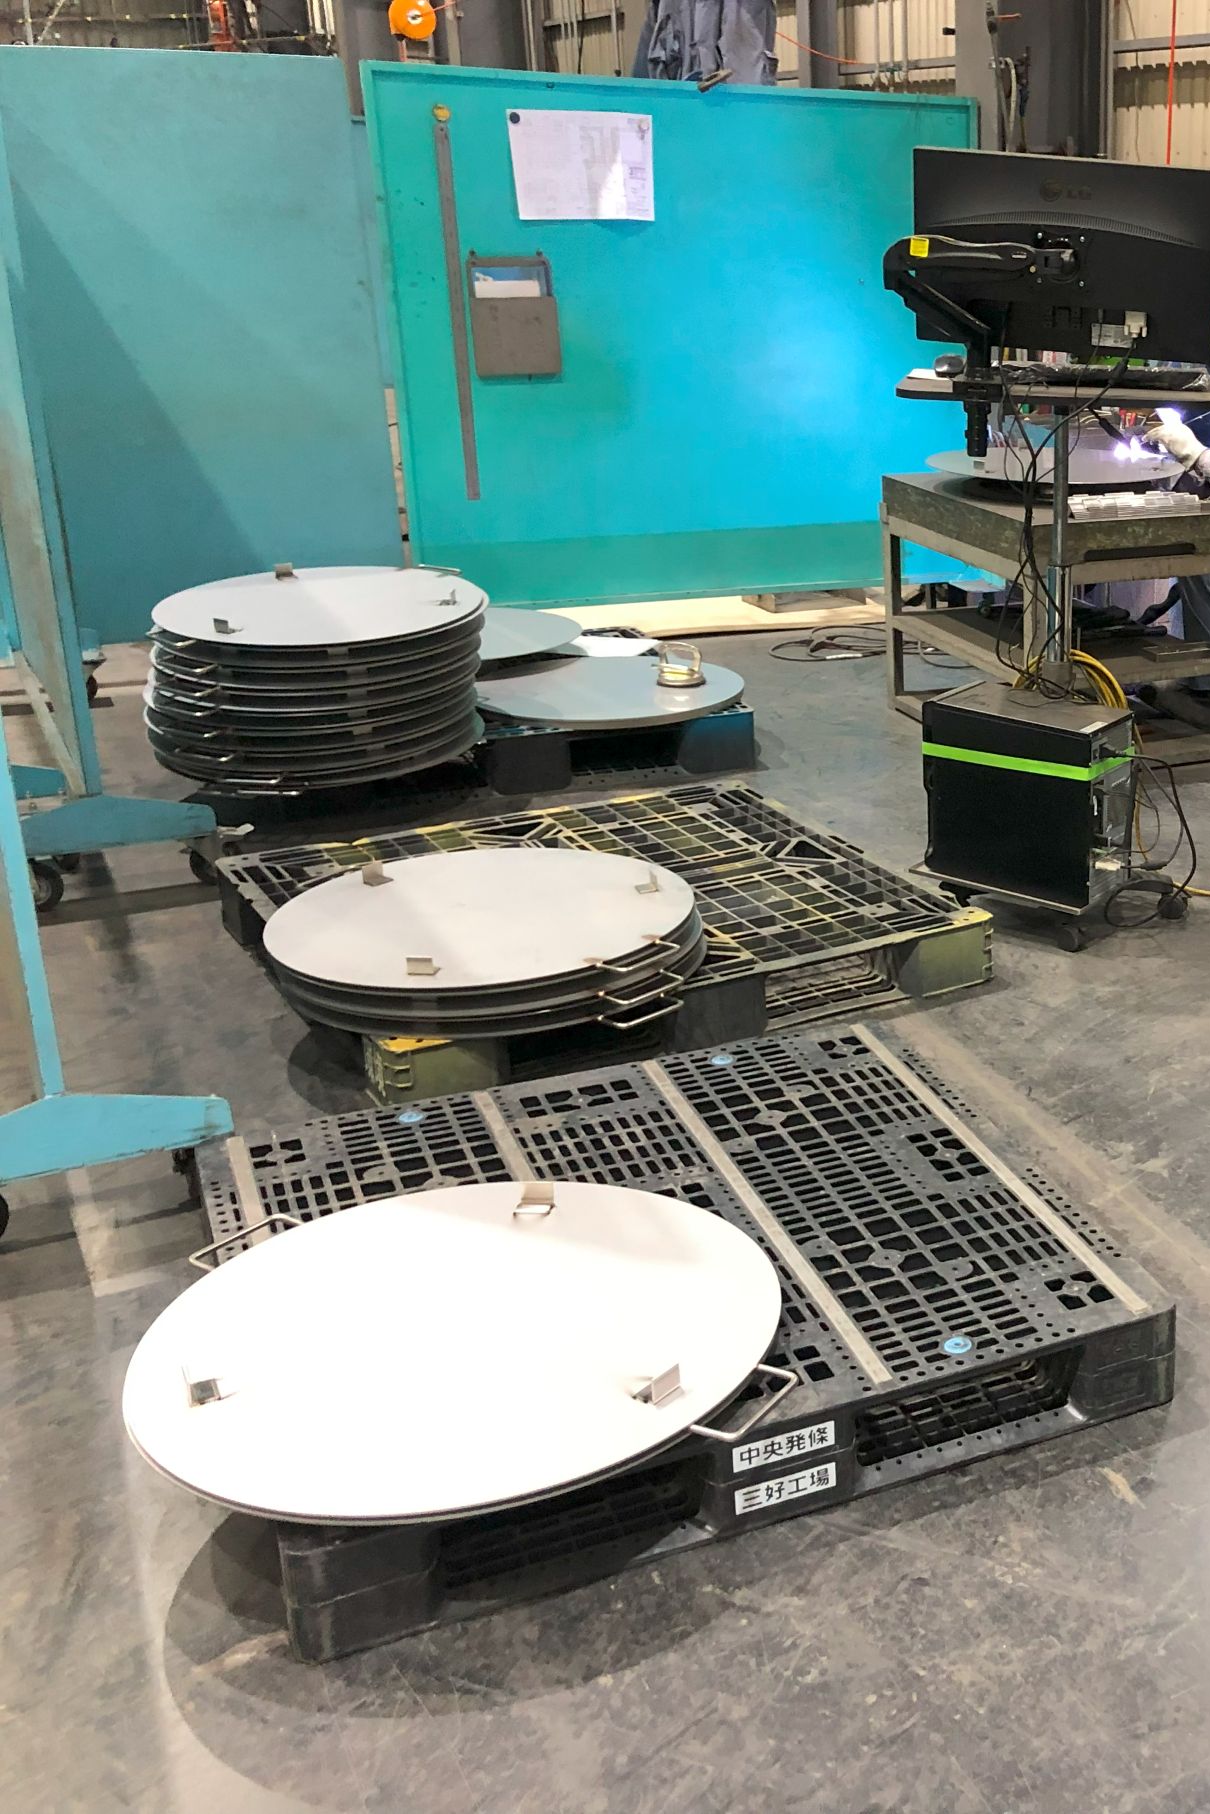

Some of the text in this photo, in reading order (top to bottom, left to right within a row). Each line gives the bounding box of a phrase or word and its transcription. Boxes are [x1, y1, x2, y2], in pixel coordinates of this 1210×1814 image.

[740, 1426, 829, 1466] 中央発條
[742, 1467, 830, 1510] 三好工場
